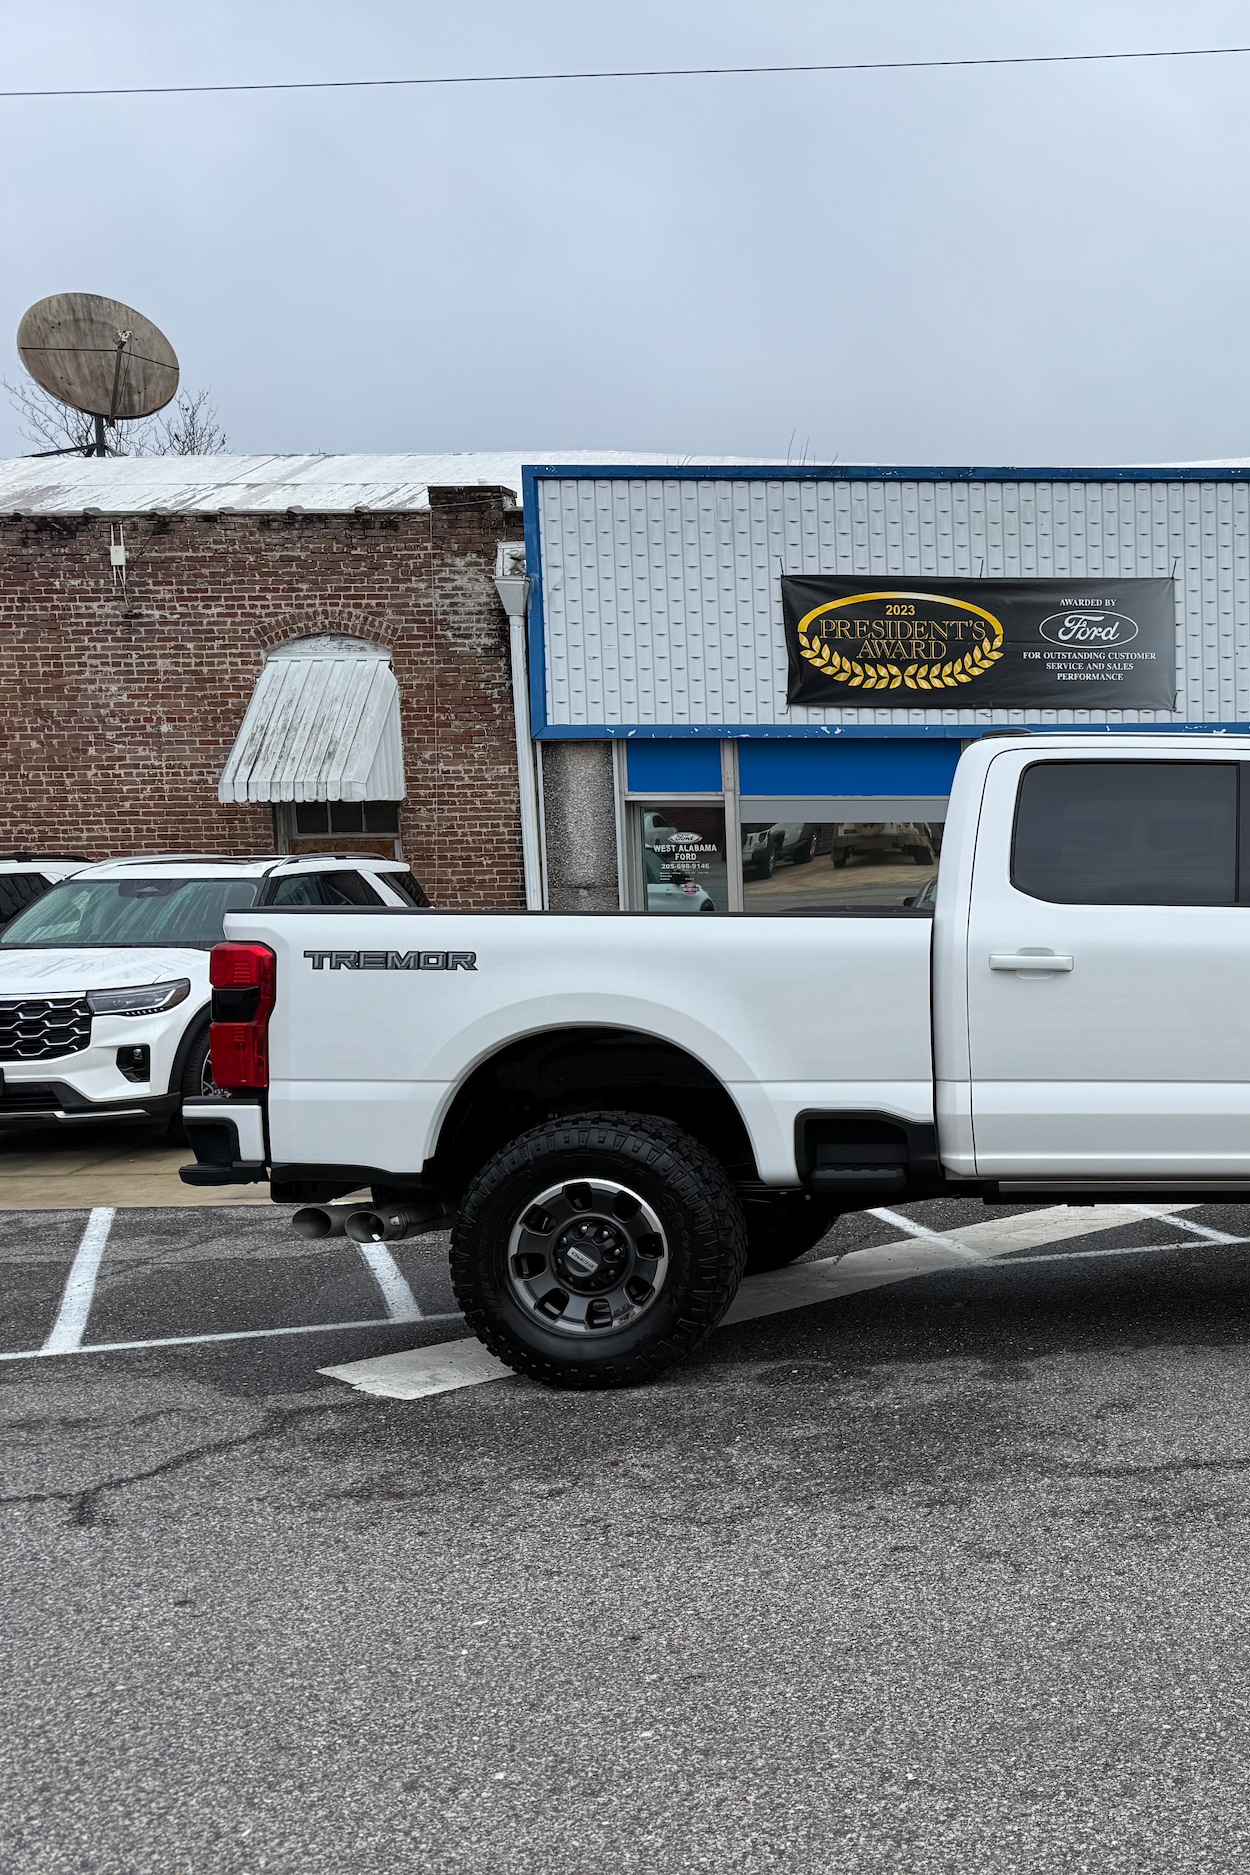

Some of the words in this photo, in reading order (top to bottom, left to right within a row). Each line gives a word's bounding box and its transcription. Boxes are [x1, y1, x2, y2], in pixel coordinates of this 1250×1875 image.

[1059, 598, 1103, 607] AWARDED
[1105, 599, 1117, 607] BY
[885, 604, 916, 616] 2023
[819, 619, 987, 641] PRESIDENT'S
[1057, 614, 1120, 641] Ford
[856, 639, 947, 660] AWARD
[1023, 651, 1042, 660] FOR
[1043, 652, 1106, 660] OUTSTANDING
[1108, 652, 1157, 660] CUSTOMER
[1046, 662, 1084, 670] SERVICE
[1086, 662, 1105, 670] AND
[1106, 663, 1134, 671] SALES
[1057, 673, 1124, 681] PERFORMANCE
[653, 844, 676, 852] WEST
[678, 843, 718, 852] ALABAMA
[674, 852, 697, 861] FORD
[303, 950, 478, 970] TREMOR
